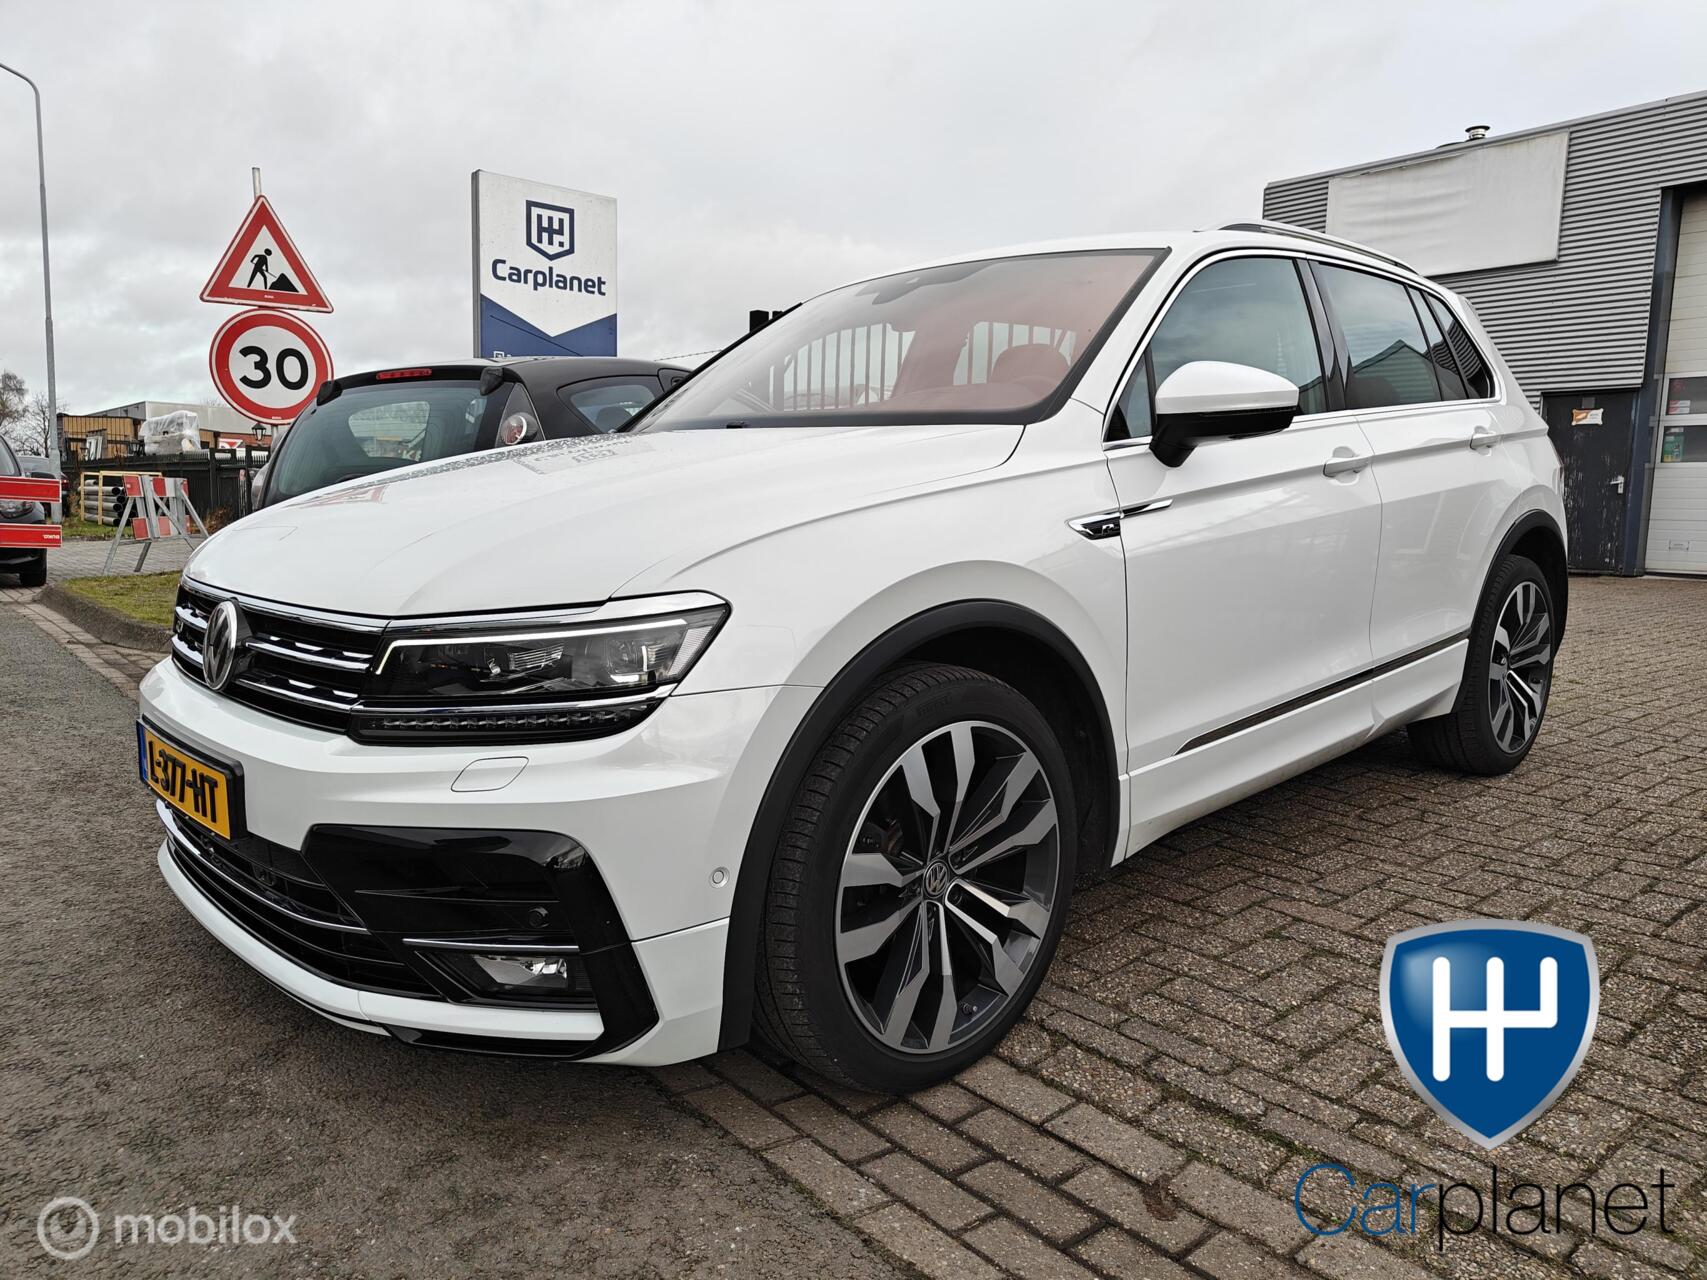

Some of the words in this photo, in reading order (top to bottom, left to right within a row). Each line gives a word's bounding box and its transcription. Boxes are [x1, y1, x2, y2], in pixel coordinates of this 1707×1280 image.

[491, 258, 606, 296] Carplanet
[239, 345, 309, 390] 30
[148, 740, 219, 824] L-377-HT
